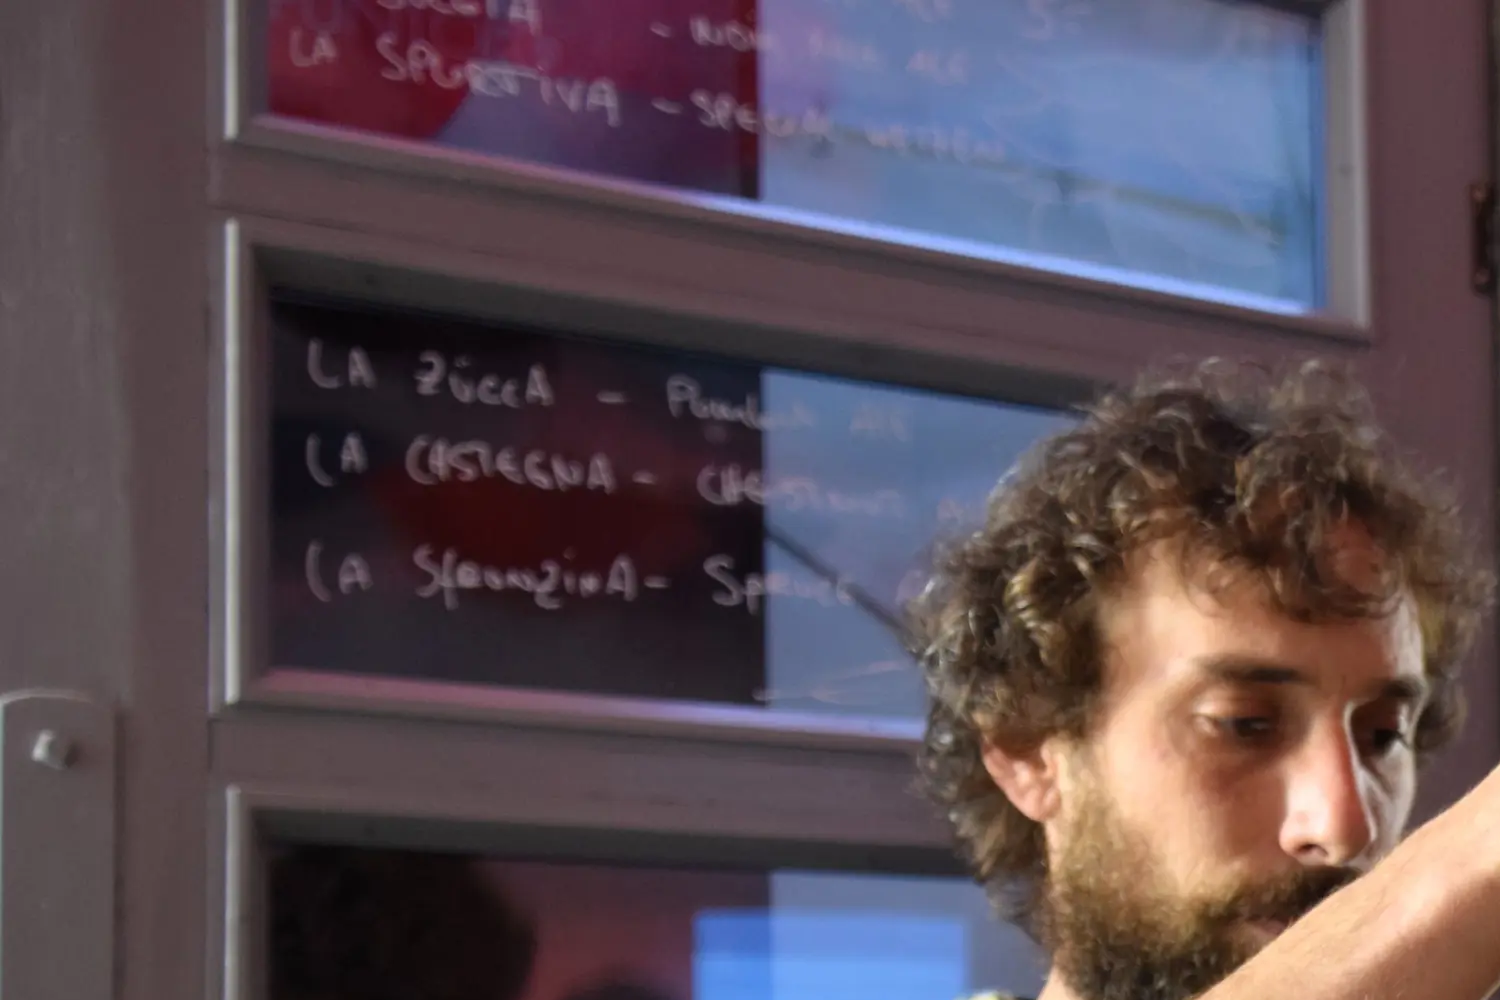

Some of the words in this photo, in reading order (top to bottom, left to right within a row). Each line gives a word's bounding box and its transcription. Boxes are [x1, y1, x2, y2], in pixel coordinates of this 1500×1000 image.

[288, 25, 338, 68] LA
[307, 338, 377, 390] LA
[306, 431, 369, 487] LA
[305, 540, 374, 602] LA
